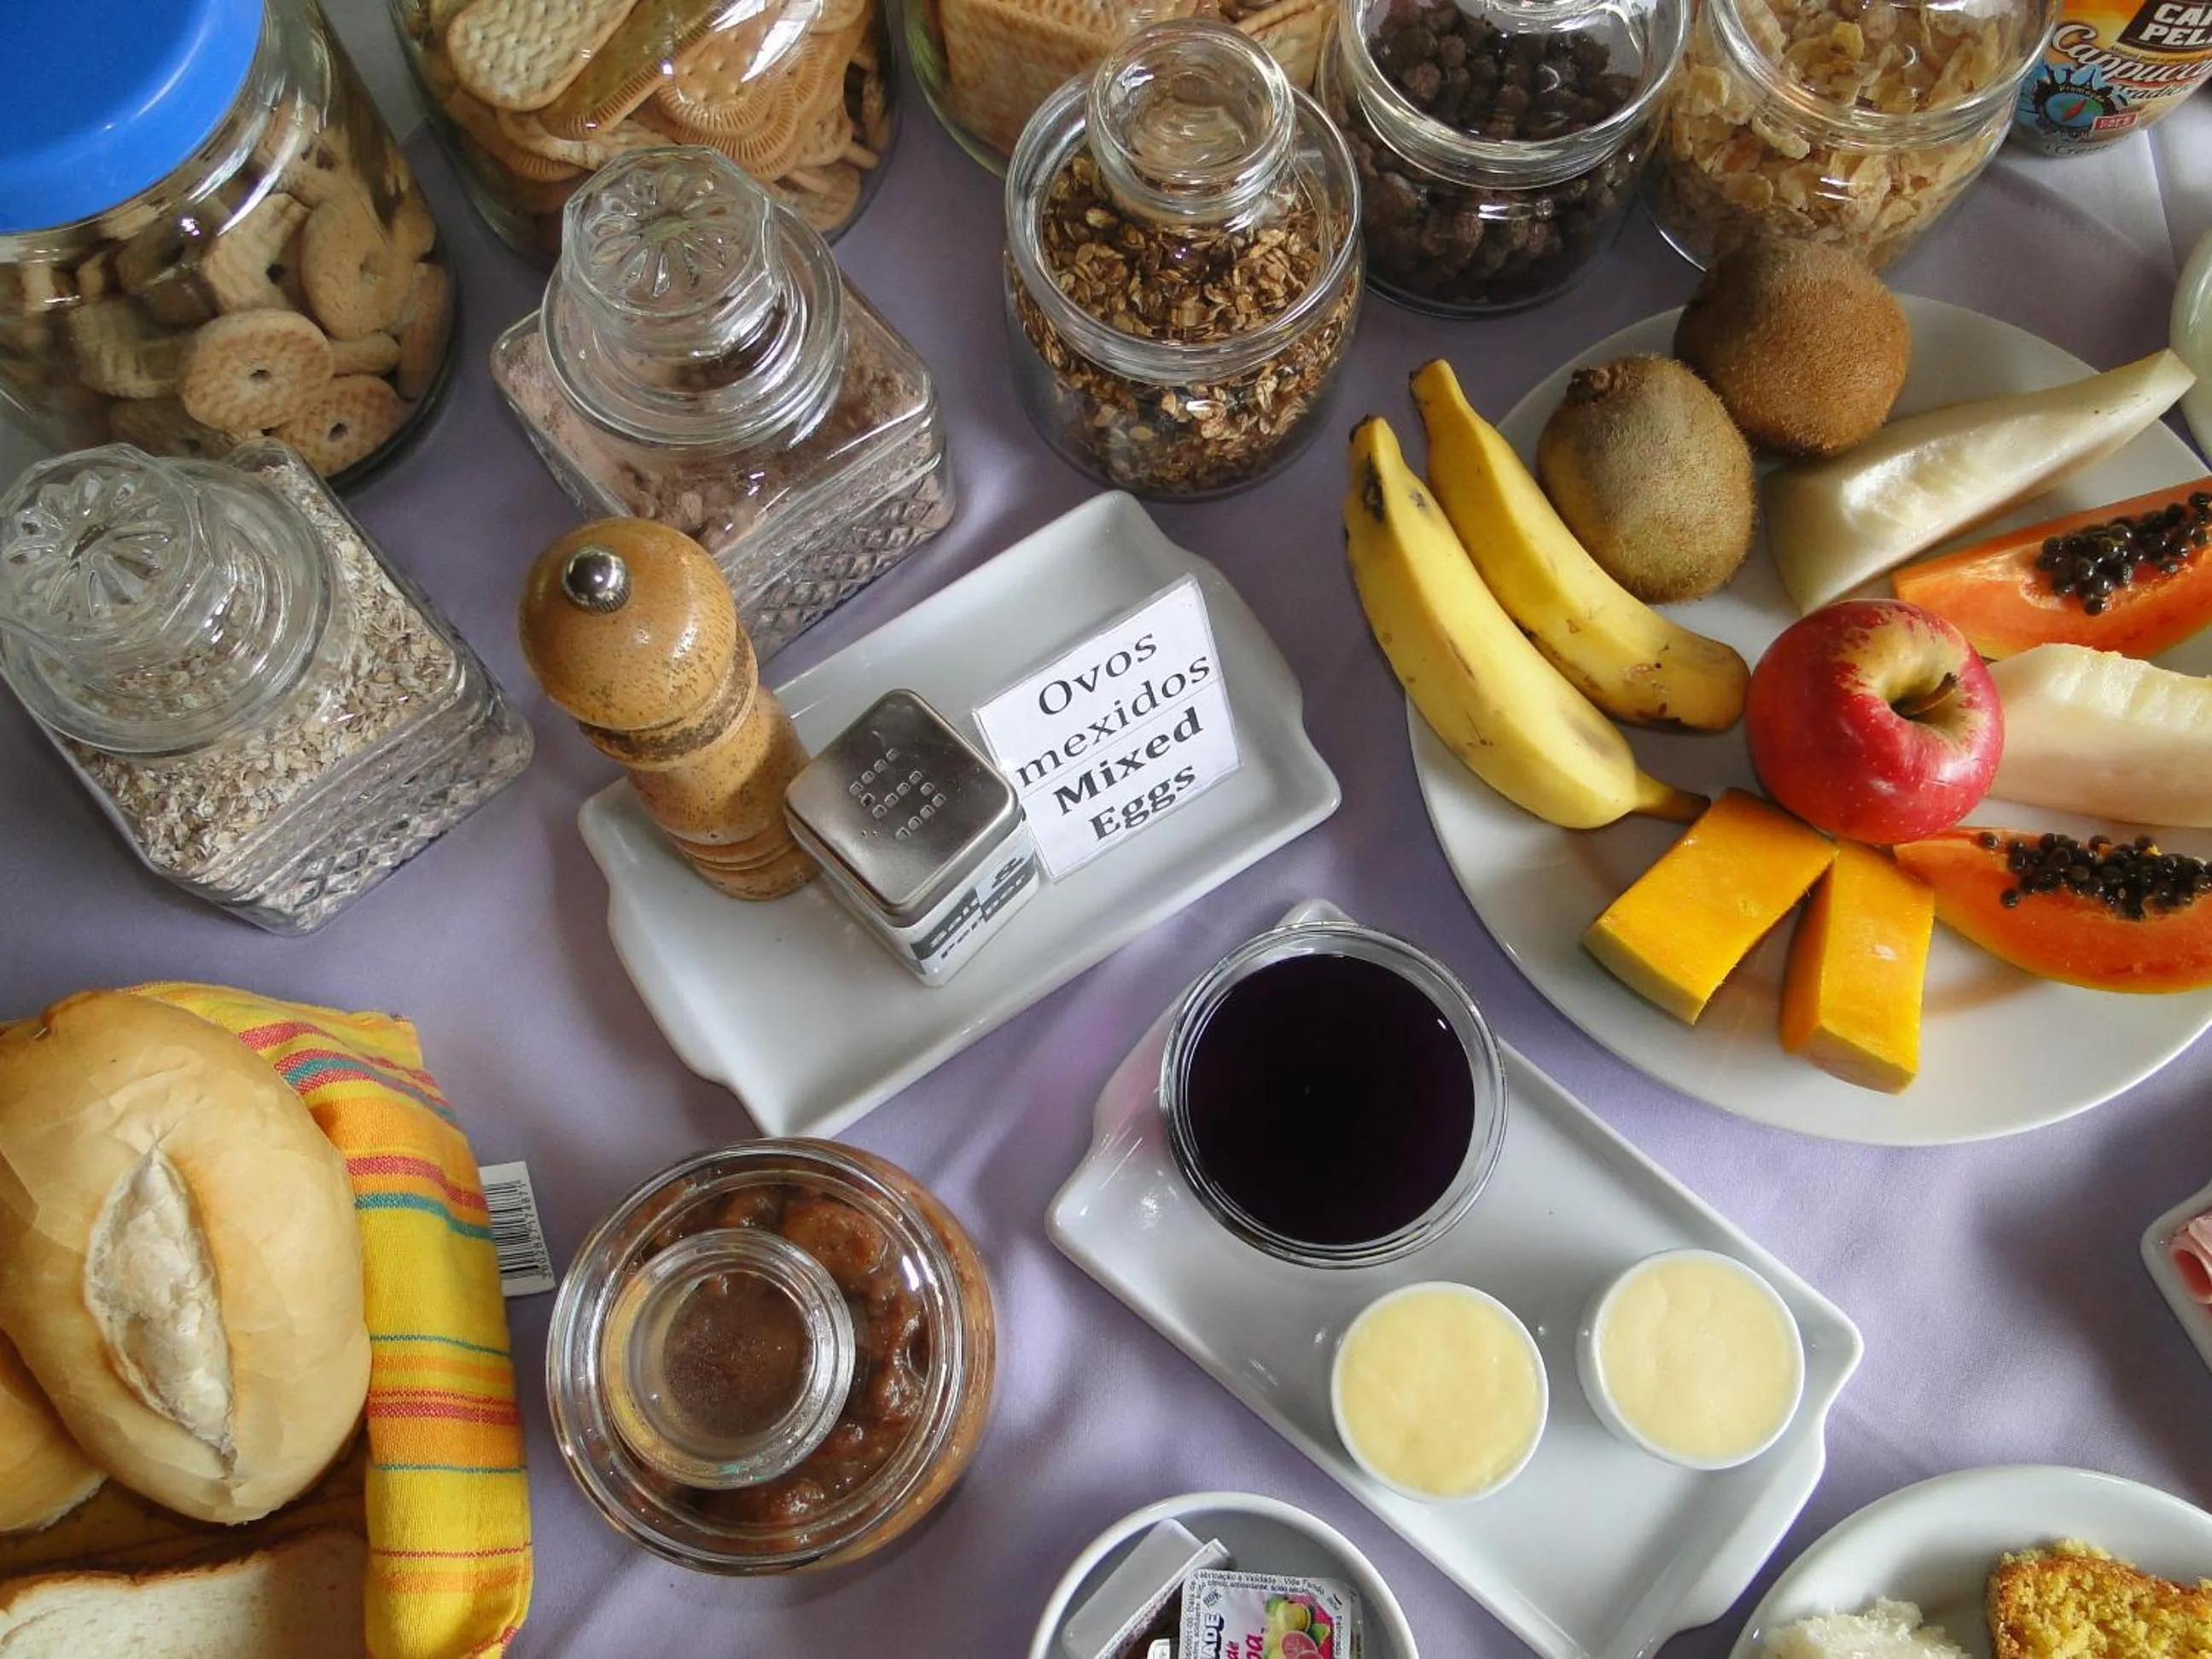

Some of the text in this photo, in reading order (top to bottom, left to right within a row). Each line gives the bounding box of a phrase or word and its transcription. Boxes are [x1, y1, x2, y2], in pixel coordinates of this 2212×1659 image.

[2139, 22, 2212, 46] PEL
[1039, 633, 1156, 715] Ovos
[1016, 655, 1209, 787] mexidos
[1053, 707, 1203, 816] Mixed
[1088, 765, 1196, 840] Eggs
[1202, 1614, 1224, 1659] ADE
